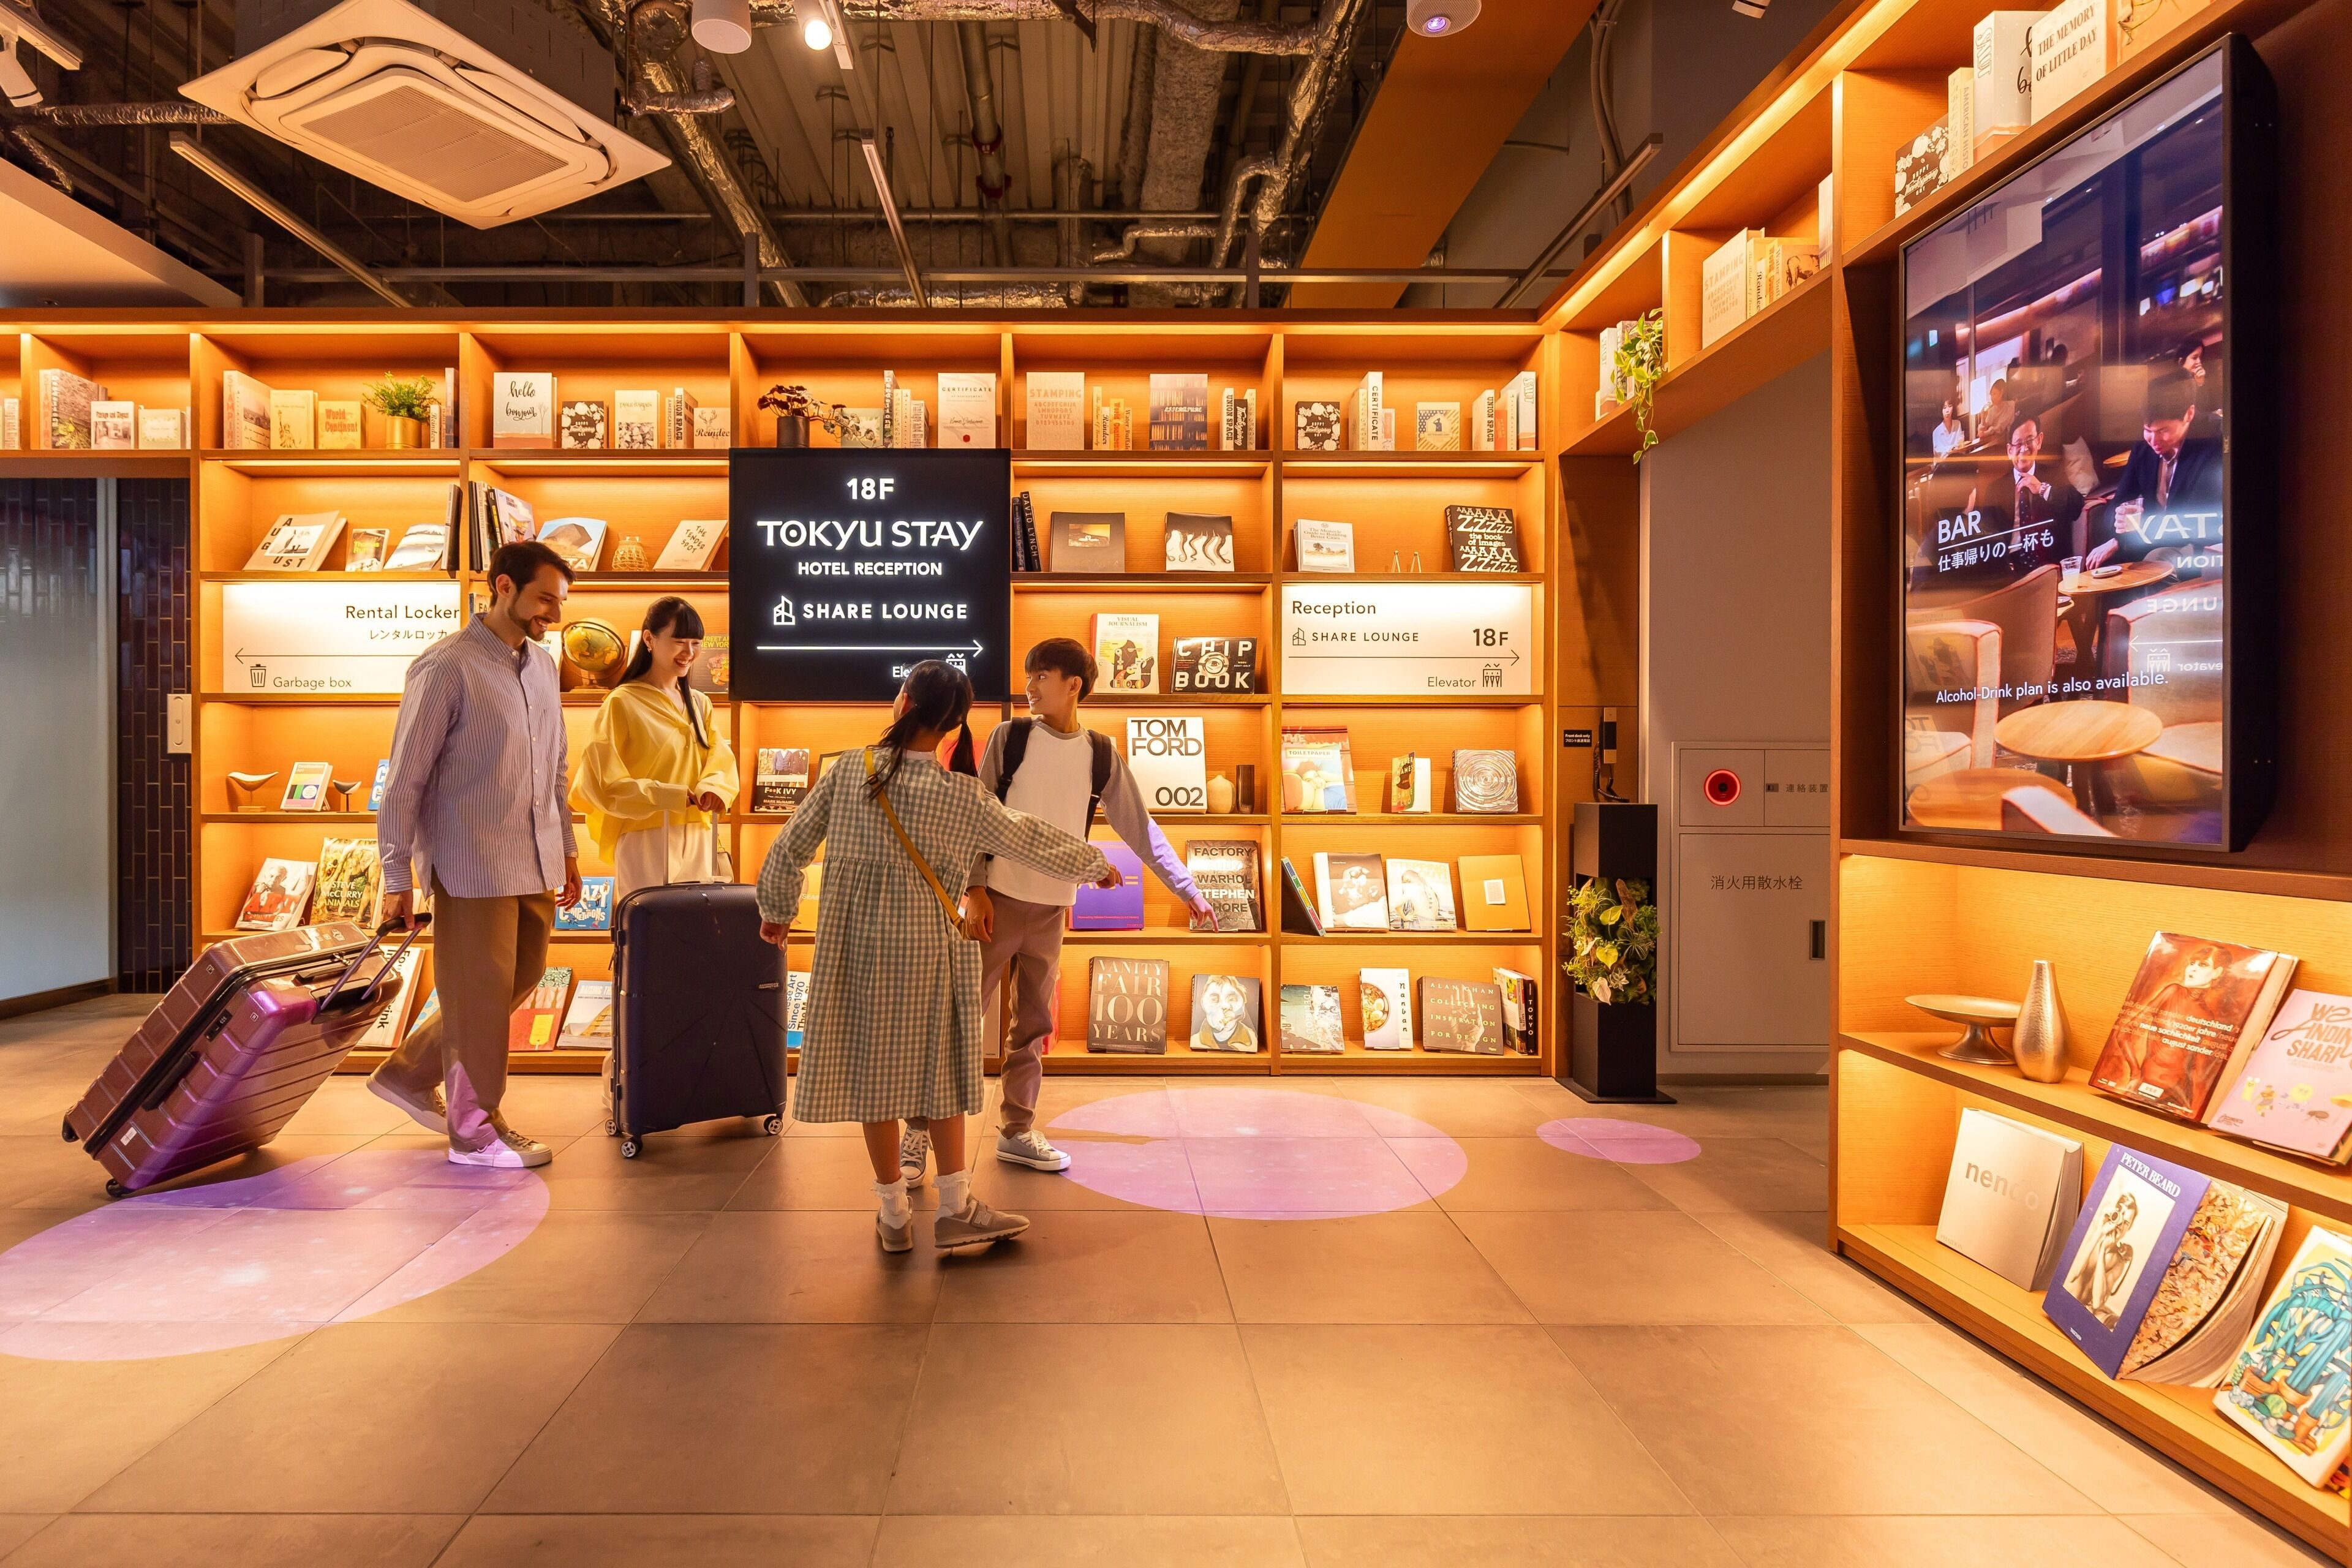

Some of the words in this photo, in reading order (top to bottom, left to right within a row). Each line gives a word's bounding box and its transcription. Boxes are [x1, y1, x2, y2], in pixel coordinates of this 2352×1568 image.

[2038, 36, 2054, 56] THE
[2057, 4, 2095, 43] MEMORY
[2036, 66, 2048, 81] OF
[2049, 43, 2078, 73] LITTLE
[2080, 27, 2097, 51] DAY
[1705, 253, 1743, 292] STAMPING
[508, 380, 535, 398] hello
[1030, 389, 1082, 398] STAMPING
[325, 409, 346, 420] World
[506, 402, 537, 421] bonjour
[325, 421, 358, 432] Continent
[846, 478, 894, 500] 18F
[696, 525, 707, 538] THE
[1022, 493, 1032, 523] DAVID
[1028, 528, 1038, 556] LYNCH
[1938, 510, 1981, 544] BAR
[685, 529, 705, 550] TENDER
[756, 520, 882, 551] TOKYU
[891, 520, 984, 551] STAY
[681, 539, 697, 554] SPOT
[1938, 529, 2054, 573] 仕事帰りの一杯も
[798, 562, 850, 575] HOTEL
[854, 562, 942, 575] RECEPTION
[345, 605, 398, 619] Rental
[405, 605, 460, 619] Locker
[803, 603, 872, 619] SHARE
[882, 603, 967, 619] LOUNGE
[1292, 601, 1376, 617] Reception
[370, 629, 447, 639] レンタルロッカ
[1312, 632, 1356, 641] SHARE
[1364, 632, 1419, 642] LOUNGE
[1473, 628, 1509, 646] 18F
[1178, 641, 1252, 657] CHIP
[273, 676, 325, 690] Garbage
[330, 676, 352, 687] box
[1175, 672, 1250, 688] BOOK
[1428, 676, 1477, 687] Elevator
[1936, 687, 2013, 703] Alcohol-Drink
[2016, 684, 2043, 698] plan
[2048, 680, 2058, 693] is
[2062, 677, 2092, 692] also
[2096, 671, 2169, 690] available.
[1131, 719, 1186, 737] TOM
[1133, 738, 1202, 756] FORD
[1786, 783, 1828, 793] 連絡装置
[1155, 787, 1204, 806] 002
[1194, 848, 1252, 856] FACTORY
[1197, 875, 1252, 884] WARHOL
[1710, 876, 1804, 891] 消火用散水栓
[1199, 889, 1254, 899] STEPHEN
[322, 899, 360, 908] ANIMALS
[1098, 959, 1163, 976] VANITY
[788, 974, 797, 989] Art
[1097, 973, 1163, 997] FAIR
[794, 981, 805, 1001] 1970
[1464, 986, 1494, 995] CHAN
[1430, 998, 1495, 1011] COLLECTING
[788, 1003, 801, 1030] Since
[1430, 1014, 1496, 1027] INSPIRATION
[1093, 1023, 1161, 1042] YEARS
[2139, 1022, 2158, 1031] neue
[1457, 1033, 1496, 1043] DESIGN
[2287, 1039, 2344, 1064] SHARI
[2120, 1152, 2150, 1181] PETER
[2149, 1170, 2181, 1198] BEARD
